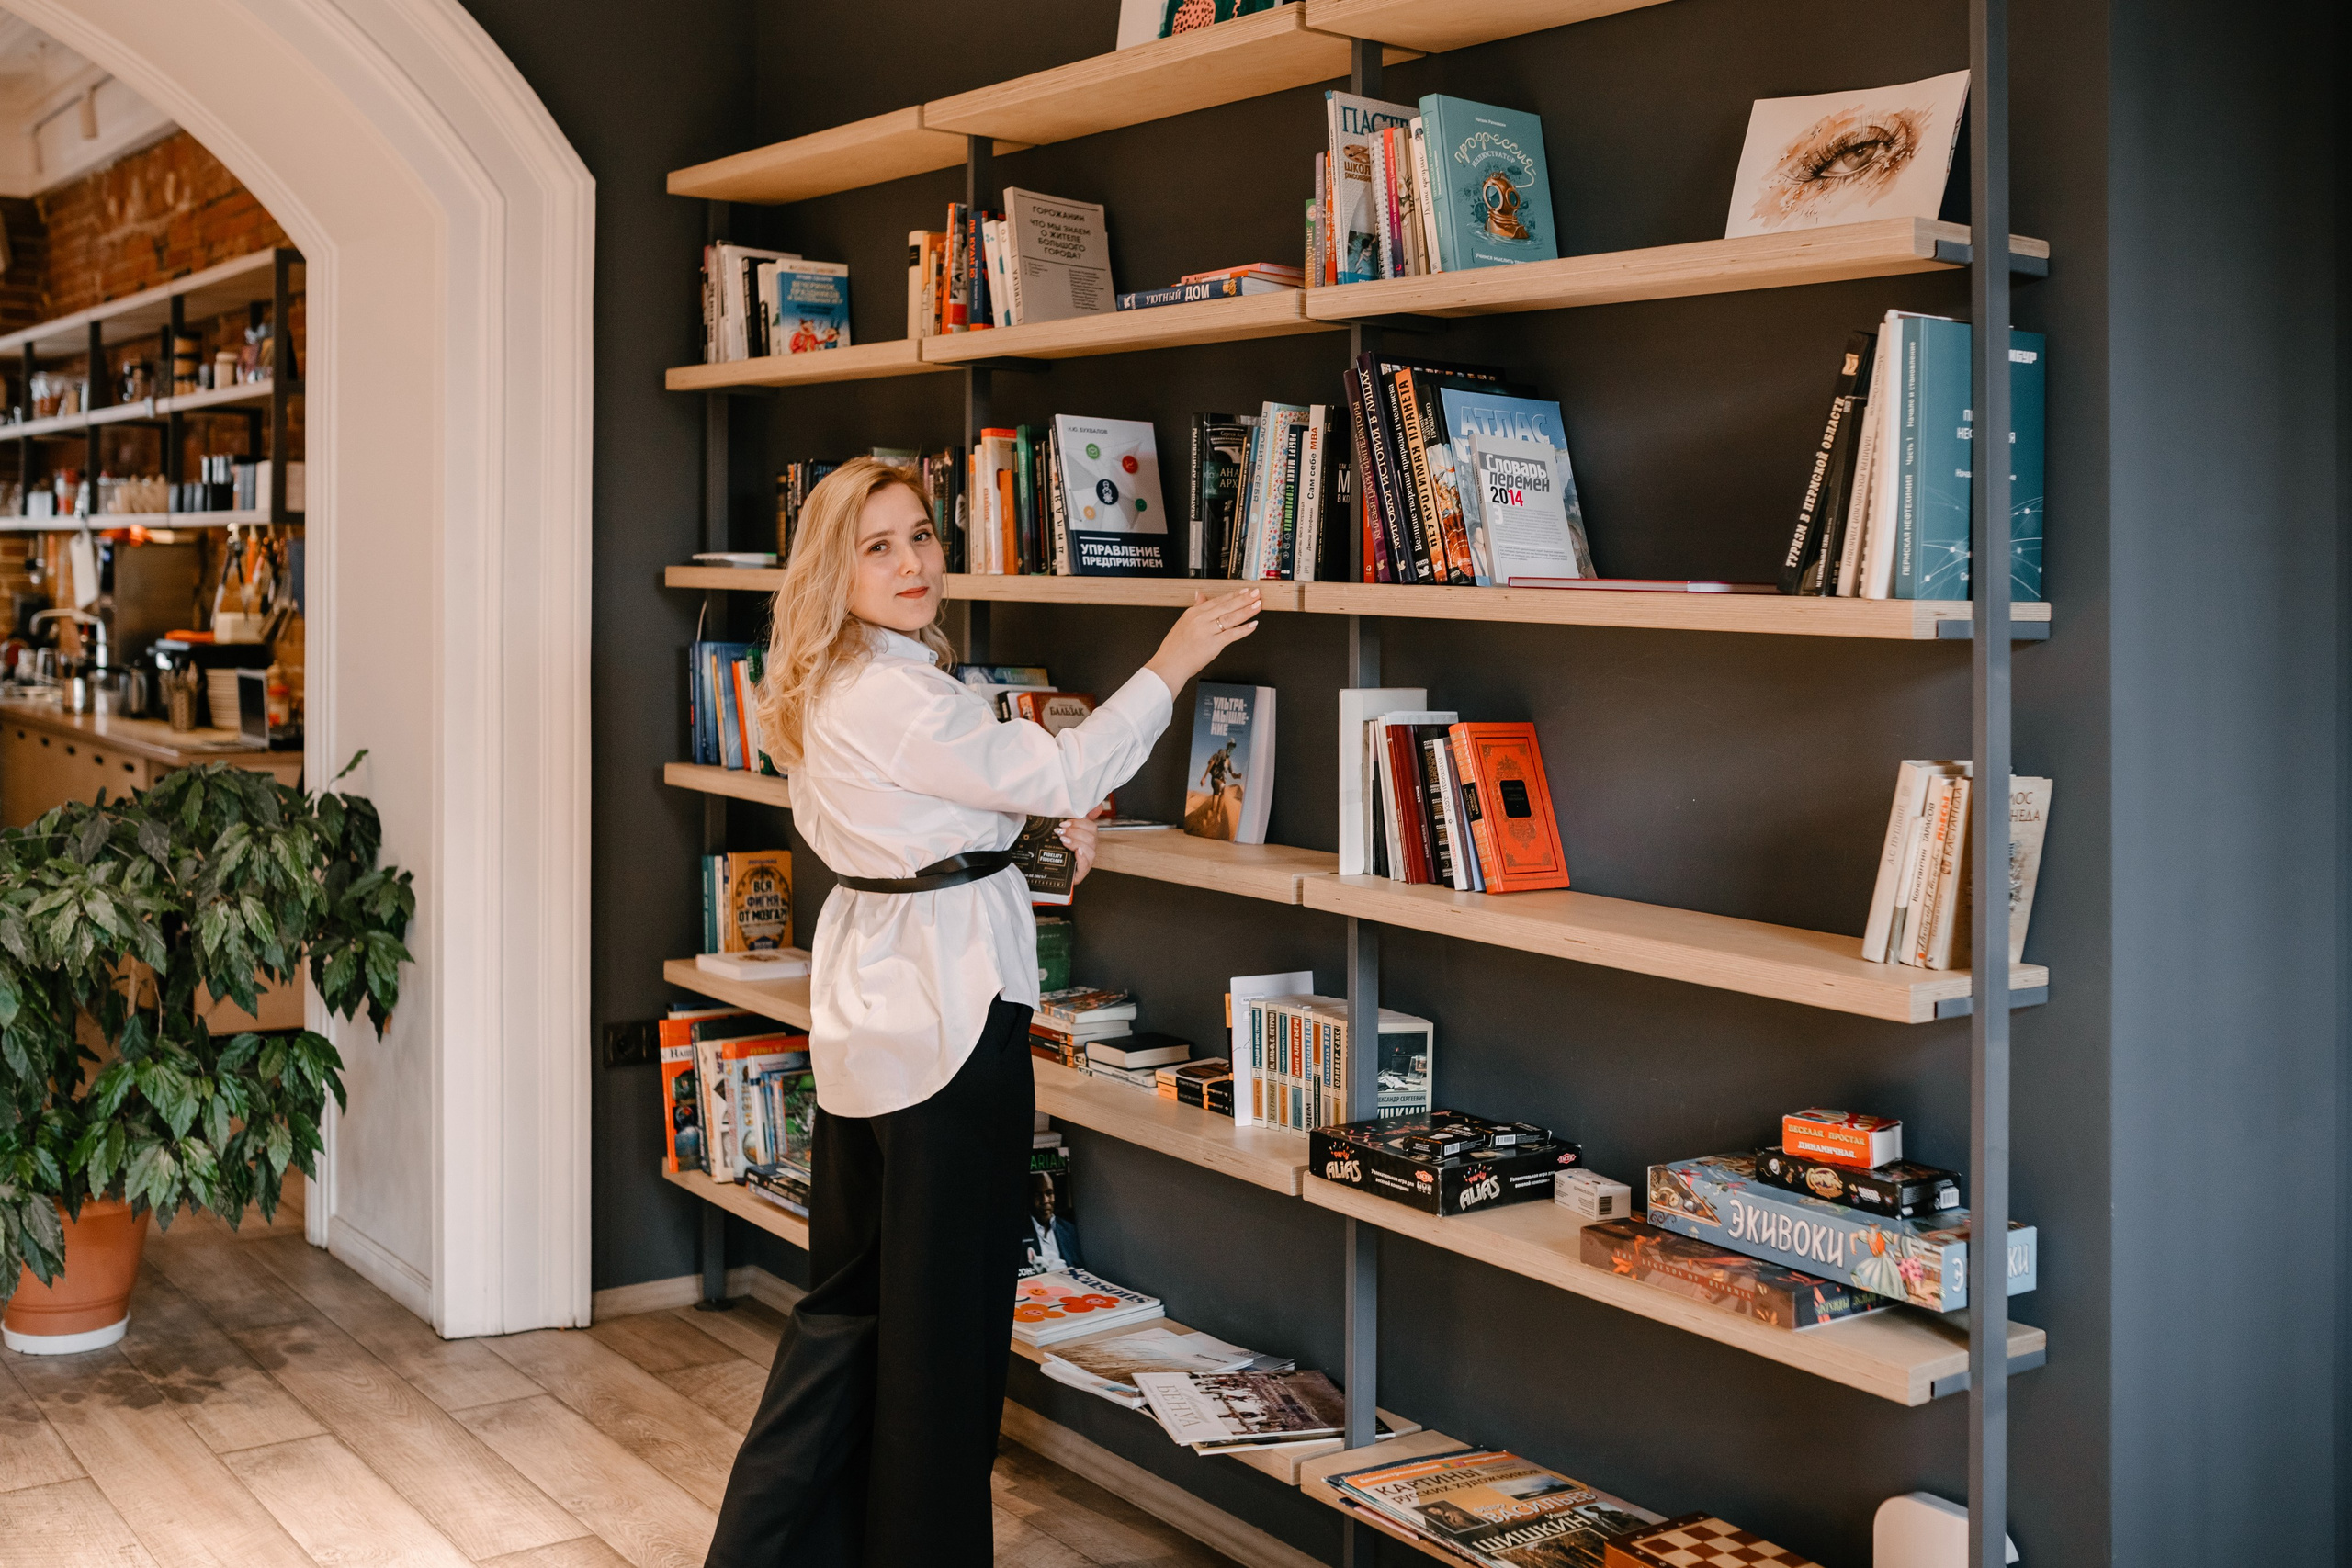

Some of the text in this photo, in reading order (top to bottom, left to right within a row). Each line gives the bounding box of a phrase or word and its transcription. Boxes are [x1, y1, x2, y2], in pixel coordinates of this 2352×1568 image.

[1341, 106, 1408, 135] ПАСТ
[1472, 150, 1516, 168] ИЛЛЮСТРАТОР
[1033, 206, 1085, 222] ГОРОЖАНИН
[1030, 219, 1091, 236] ЧТО МЫ ЗНАЕМ
[1049, 231, 1081, 243] ЖИТЕЛЕ
[1038, 237, 1086, 252] БОЛЬШОГО
[1044, 246, 1081, 260] ГОРОДА?
[969, 267, 975, 278] Ю
[1012, 268, 1021, 307] STRELKA
[1146, 284, 1210, 305] УЮТНЫЙ ДОМ
[1873, 354, 1883, 385] Максим
[1907, 342, 1916, 391] становление
[1387, 383, 1400, 423] человека
[1905, 400, 1915, 428] Начало
[1425, 401, 1436, 438] ПРОШЛОГО
[1461, 406, 1551, 444] АТЛАС
[1252, 410, 1267, 502] ПОЛЮБИТЬ СЕБЯ
[1307, 452, 1317, 476] себе
[1360, 369, 1401, 549] МИРОВАЯ ИСТОРИЯ В ЛИЦАХ
[1396, 431, 1410, 471] природы
[1397, 378, 1438, 547] НЕУКРОТИМАЯ ПЛАНЕТА
[1905, 443, 1914, 465] Часть
[1486, 454, 1548, 479] Словарь
[1283, 433, 1296, 532] РОБЕРТ МАККИ СТОРИНОМИКА
[1307, 479, 1316, 500] Сам
[1403, 471, 1417, 513] творения
[1489, 472, 1550, 492] перемен
[1785, 394, 1845, 568] ТУРИЗМ В ПЕРМСКОЙ ОБЛАСТИ
[1490, 486, 1523, 506] 2014
[1844, 435, 1872, 567] ПАЛИТРА РОССИЙСКОЙ УПАКОВКИ
[1903, 473, 1913, 530] НЕФТЕХИМИЯ
[1408, 513, 1422, 551] Великие
[1080, 543, 1161, 558] УПРАВЛЕНИЕ
[1082, 557, 1163, 569] ПРЕДПРИЯТИЕМ
[1901, 531, 1911, 575] ПЕРМСКАЯ
[1049, 706, 1084, 716] БАЛЬЗАК
[1214, 697, 1247, 711] УЛЬТРА-
[1211, 723, 1228, 736] НИЕ
[1213, 710, 1249, 725] МЫШЛЕ-
[1890, 804, 1905, 847] ПУШКИН
[1936, 795, 1950, 840] ПЬЕСЫ
[1943, 786, 1963, 856] КАСТАНЕДА
[1911, 848, 1927, 901] Константин
[1921, 801, 1935, 842] ТАРАСОВ
[753, 880, 772, 893] ВСЯ
[747, 895, 779, 907] ФИГНЯ
[739, 912, 749, 922] ОТ
[1371, 1168, 1397, 1181] Увлекательная
[1391, 1182, 1409, 1192] компании
[1468, 1170, 1487, 1184] party
[1510, 1174, 1539, 1183] Увлекательная
[1726, 1198, 1845, 1269] ЭКИВОКИ
[1641, 1258, 1684, 1278] LEGENDS
[1687, 1273, 1699, 1281] OF
[1156, 1385, 1201, 1427] БЕНУА
[1374, 1469, 1482, 1496] КАРТИНЫ
[1391, 1469, 1542, 1505] русских художников
[1483, 1492, 1599, 1524] ВАСИЛЬЕВ
[1544, 1508, 1573, 1520] Иван
[1471, 1515, 1594, 1553] ШИШКИН
